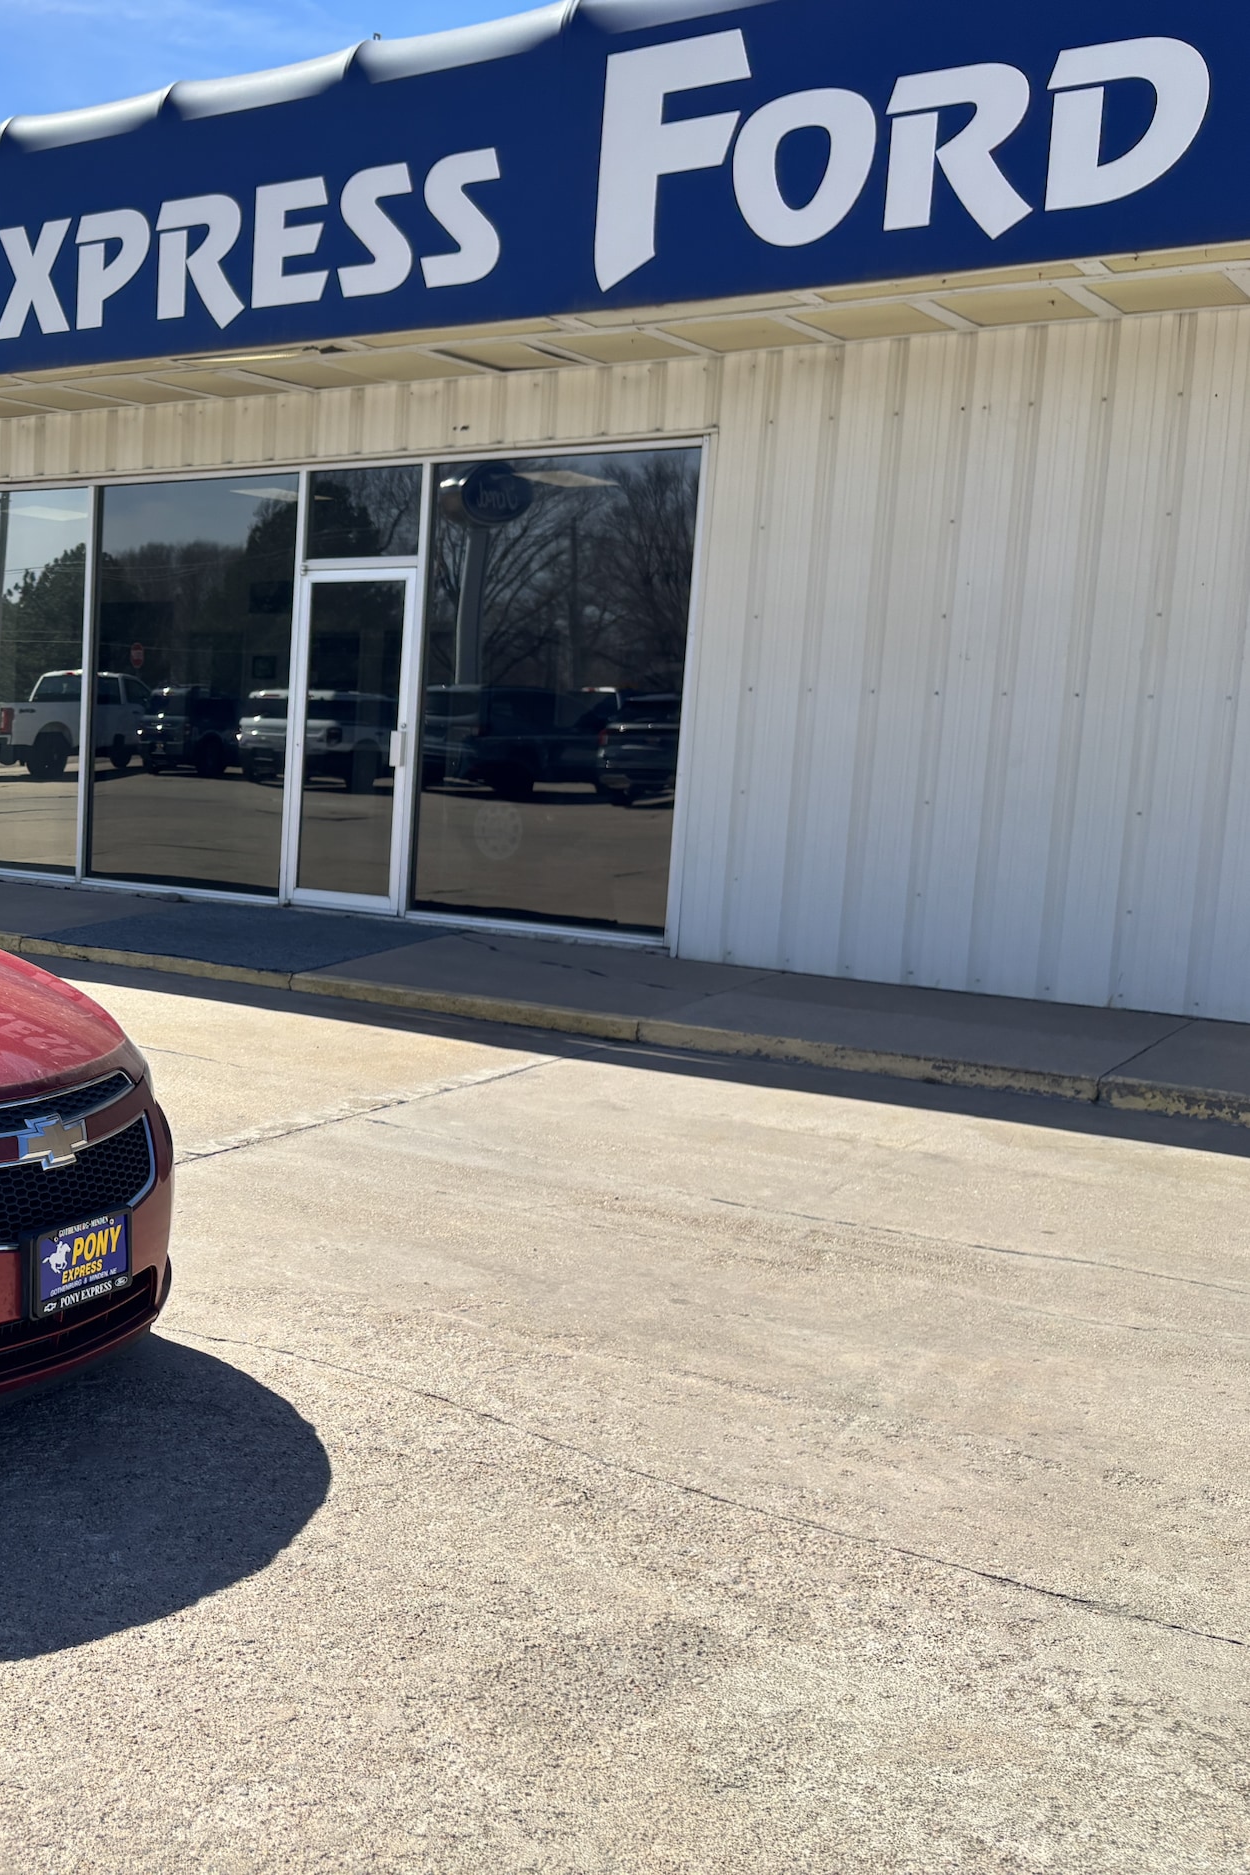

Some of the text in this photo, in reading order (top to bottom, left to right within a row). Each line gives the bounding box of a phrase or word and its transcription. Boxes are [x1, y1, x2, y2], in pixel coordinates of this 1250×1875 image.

[594, 28, 1210, 292] FORD
[71, 1224, 122, 1266] PONY
[61, 1258, 103, 1284] EXPRESS
[60, 1291, 81, 1308] PONY
[81, 1280, 113, 1301] EXPRESS
